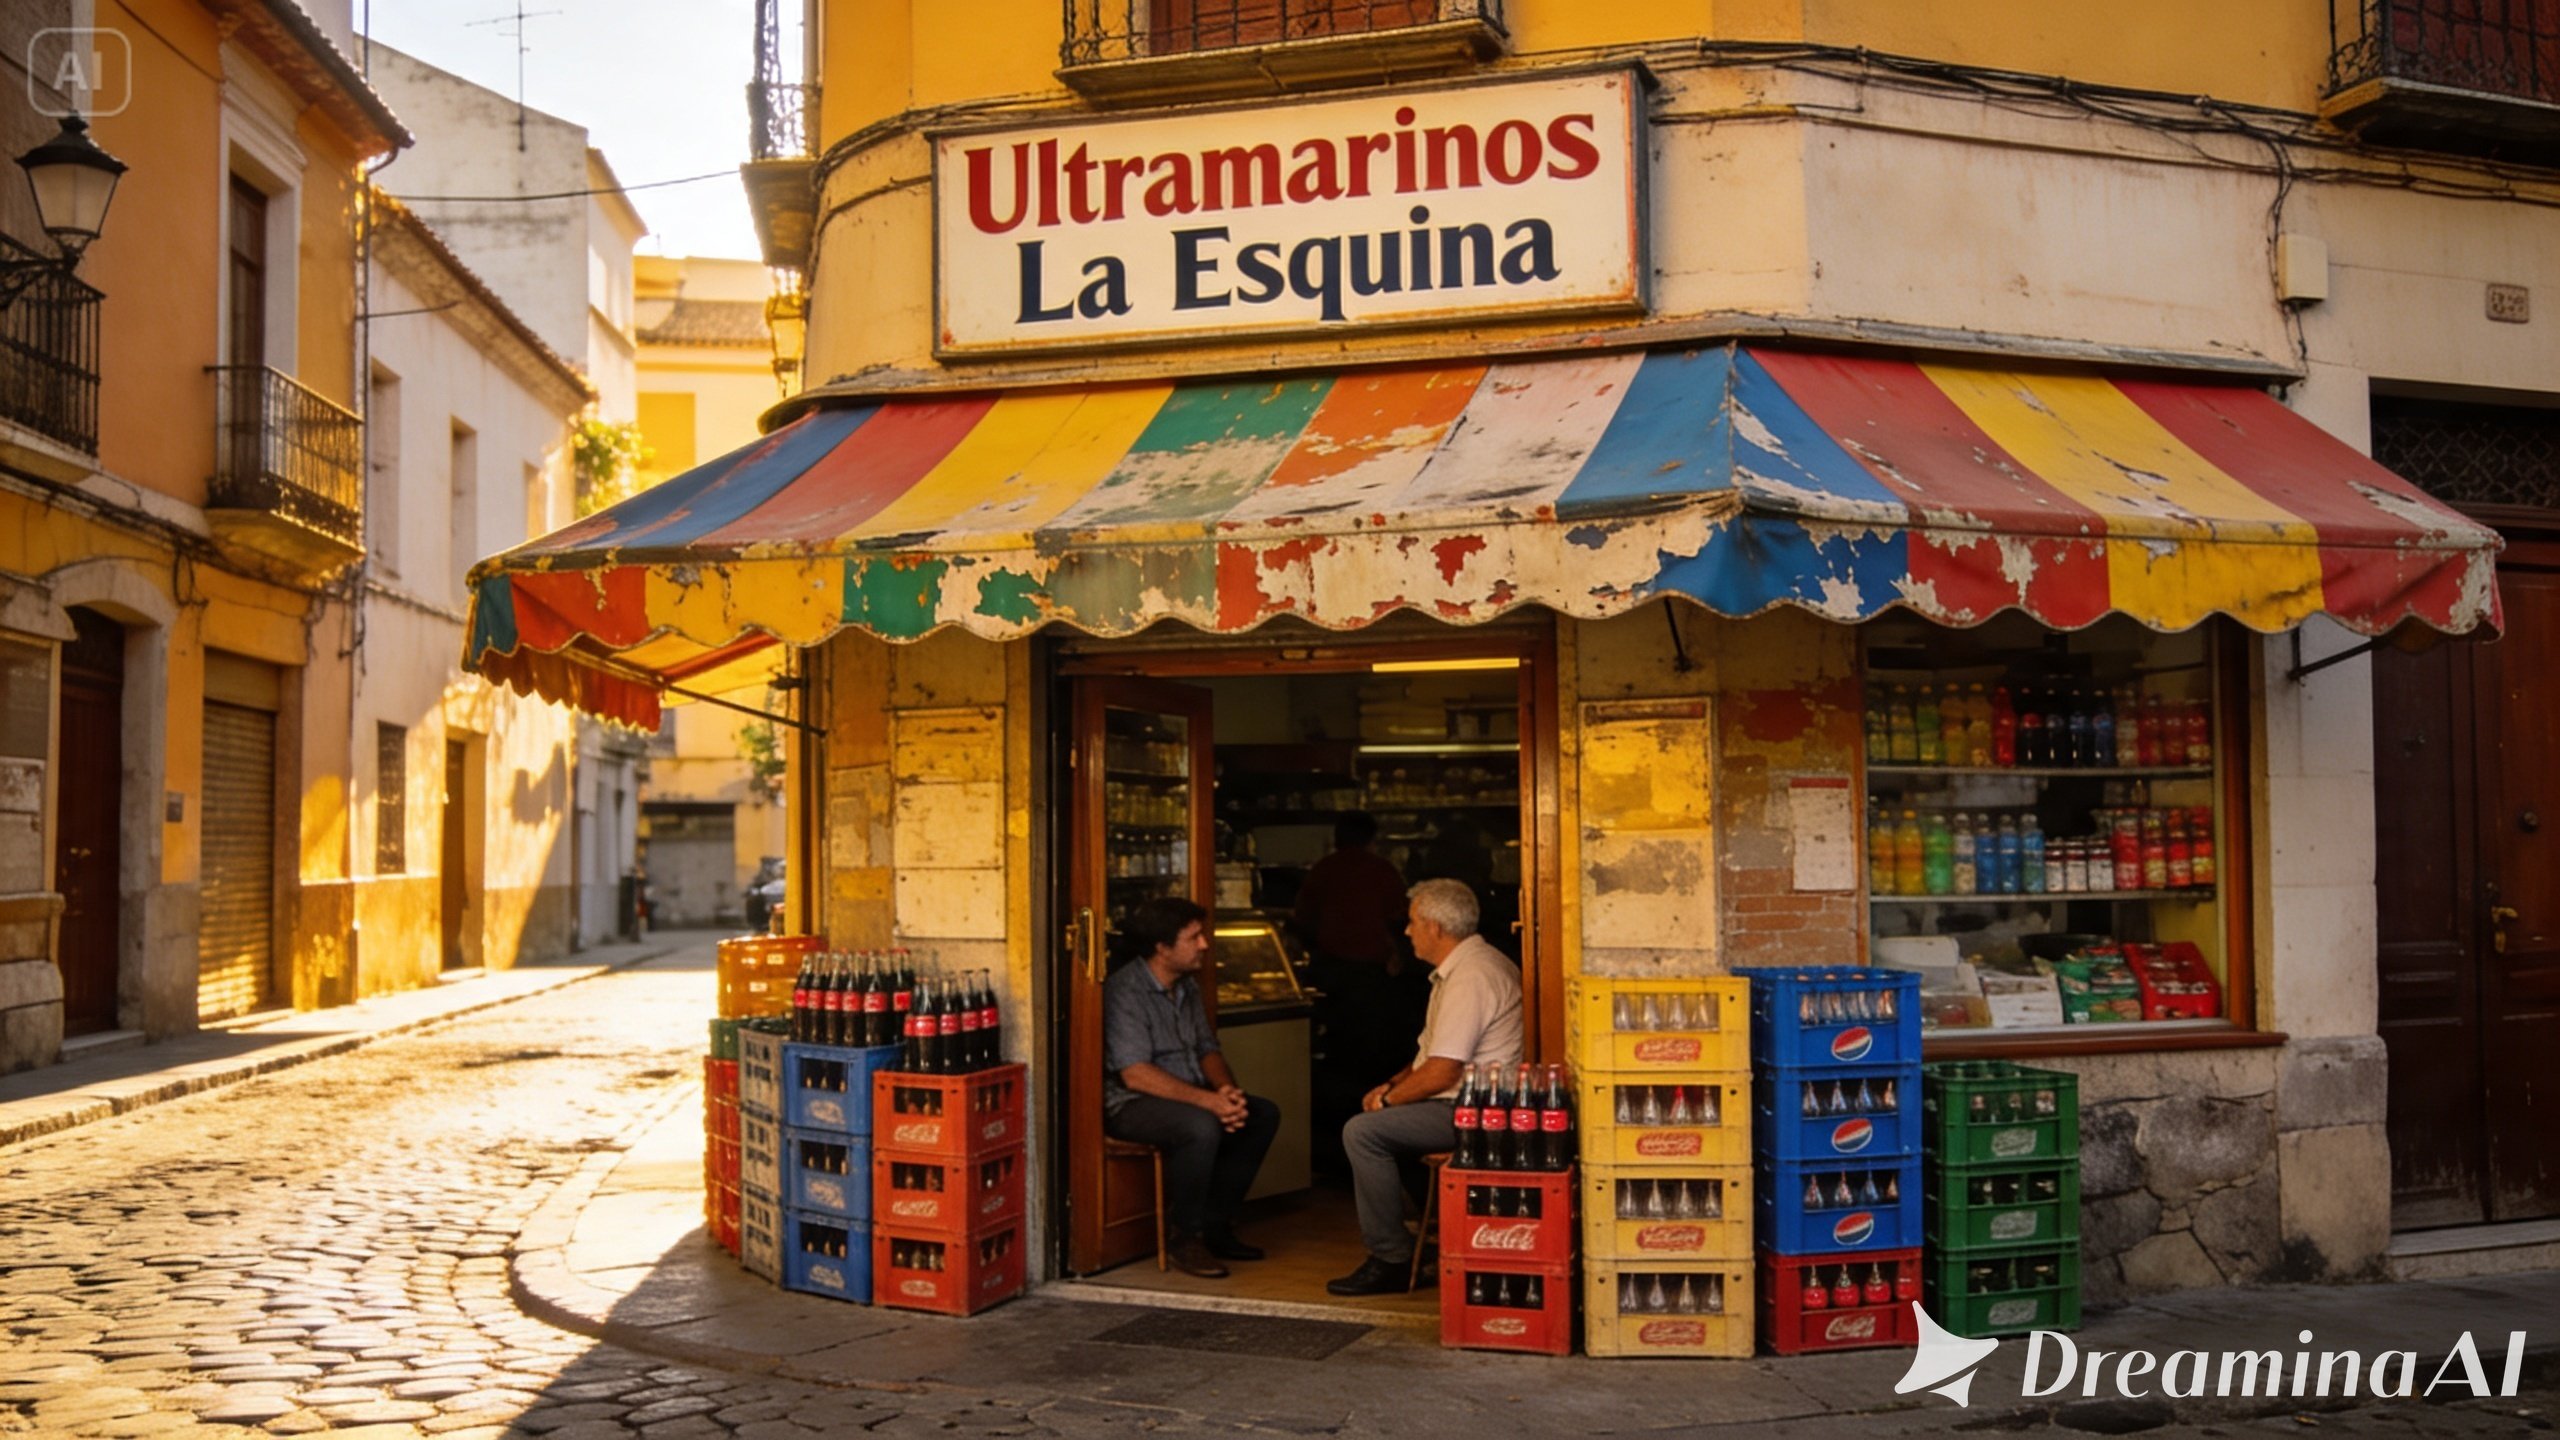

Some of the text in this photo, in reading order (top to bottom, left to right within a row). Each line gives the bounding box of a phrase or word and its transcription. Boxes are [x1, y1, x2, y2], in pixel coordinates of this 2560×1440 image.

[964, 106, 1600, 235] Ultramarinos
[1016, 205, 1561, 324] La Esquina
